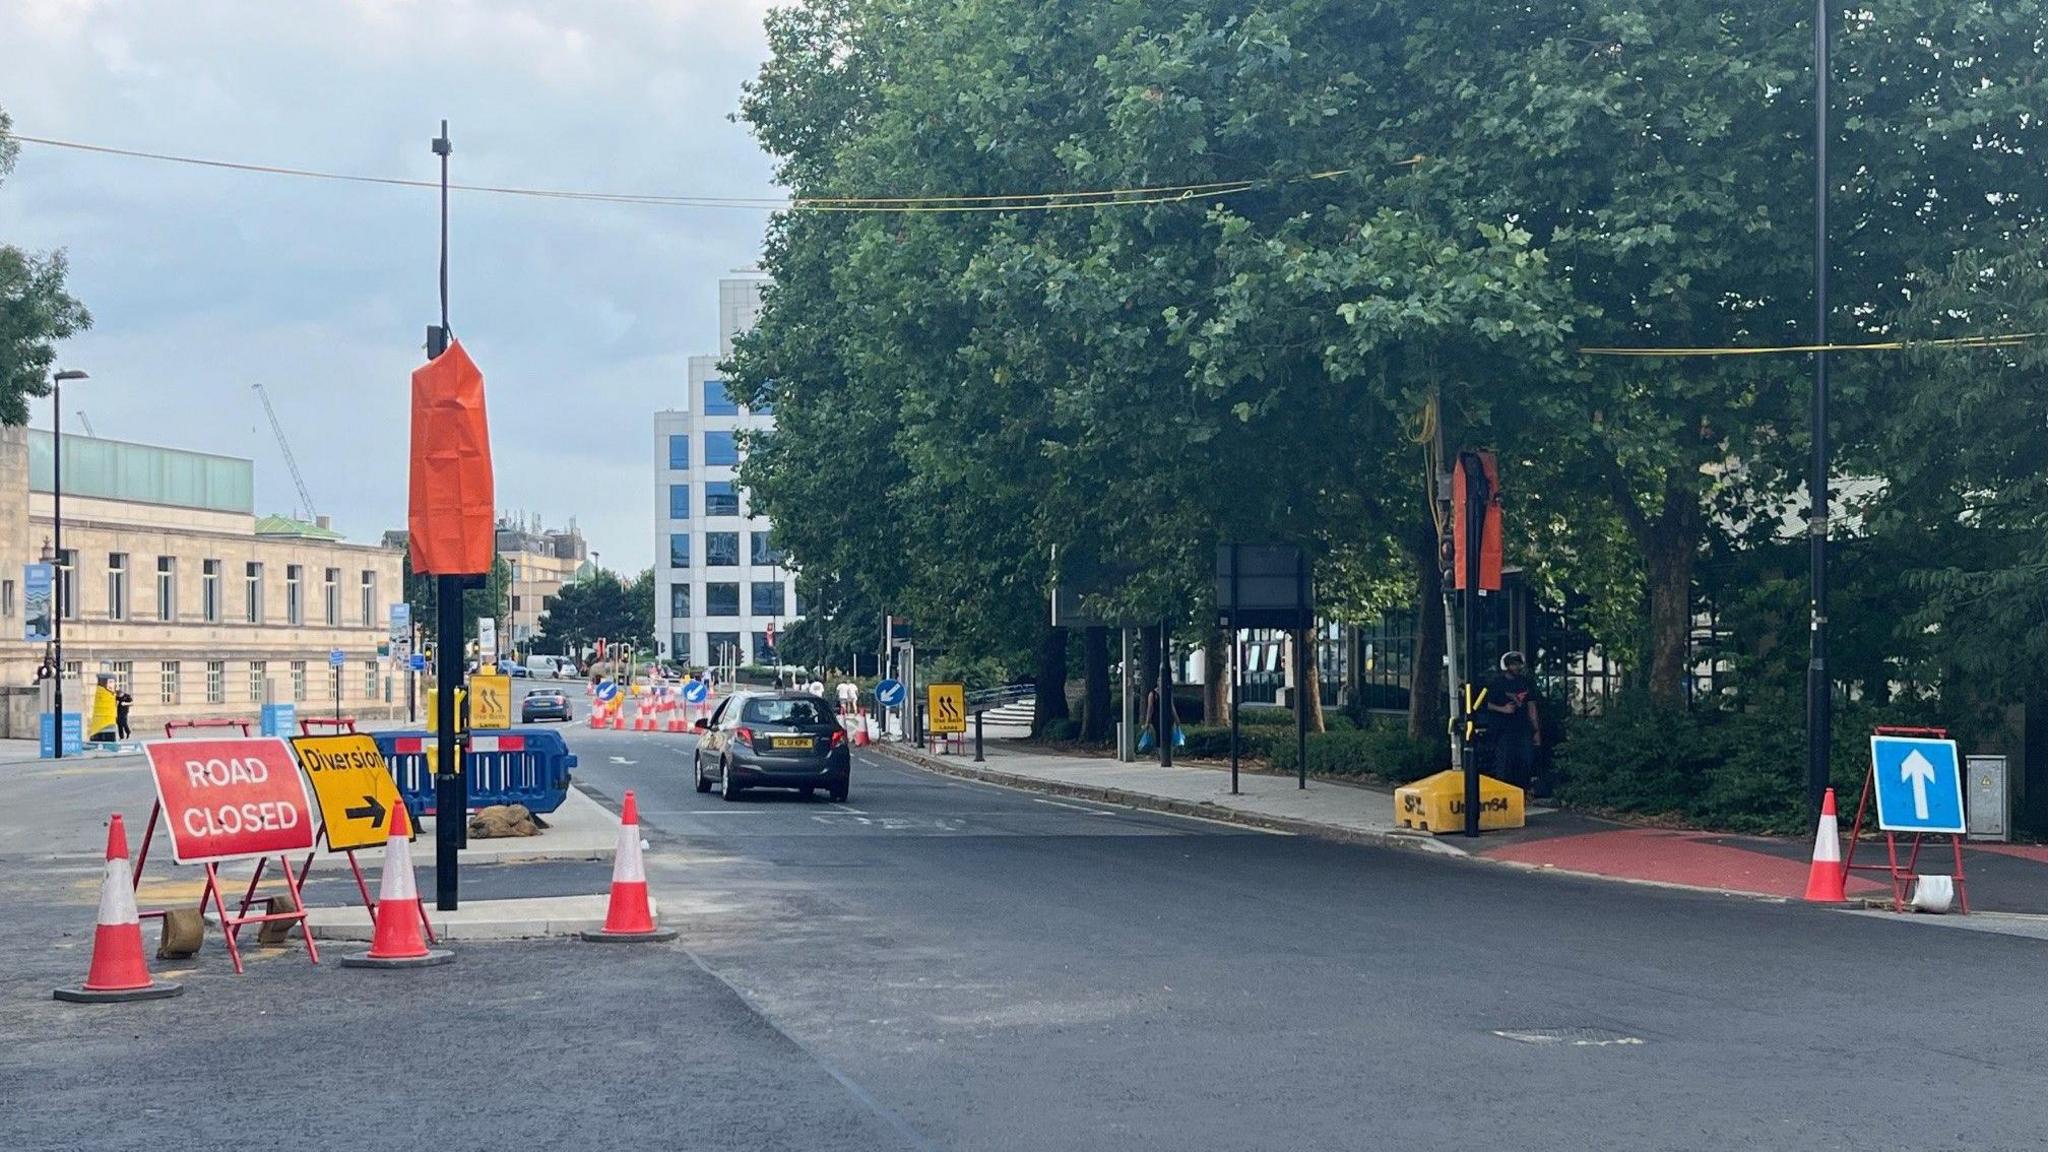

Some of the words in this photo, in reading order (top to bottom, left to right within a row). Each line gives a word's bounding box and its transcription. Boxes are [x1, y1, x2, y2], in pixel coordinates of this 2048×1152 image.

[185, 757, 269, 788] ROAD
[303, 746, 385, 772] Diversion
[184, 801, 298, 838] CLOSED
